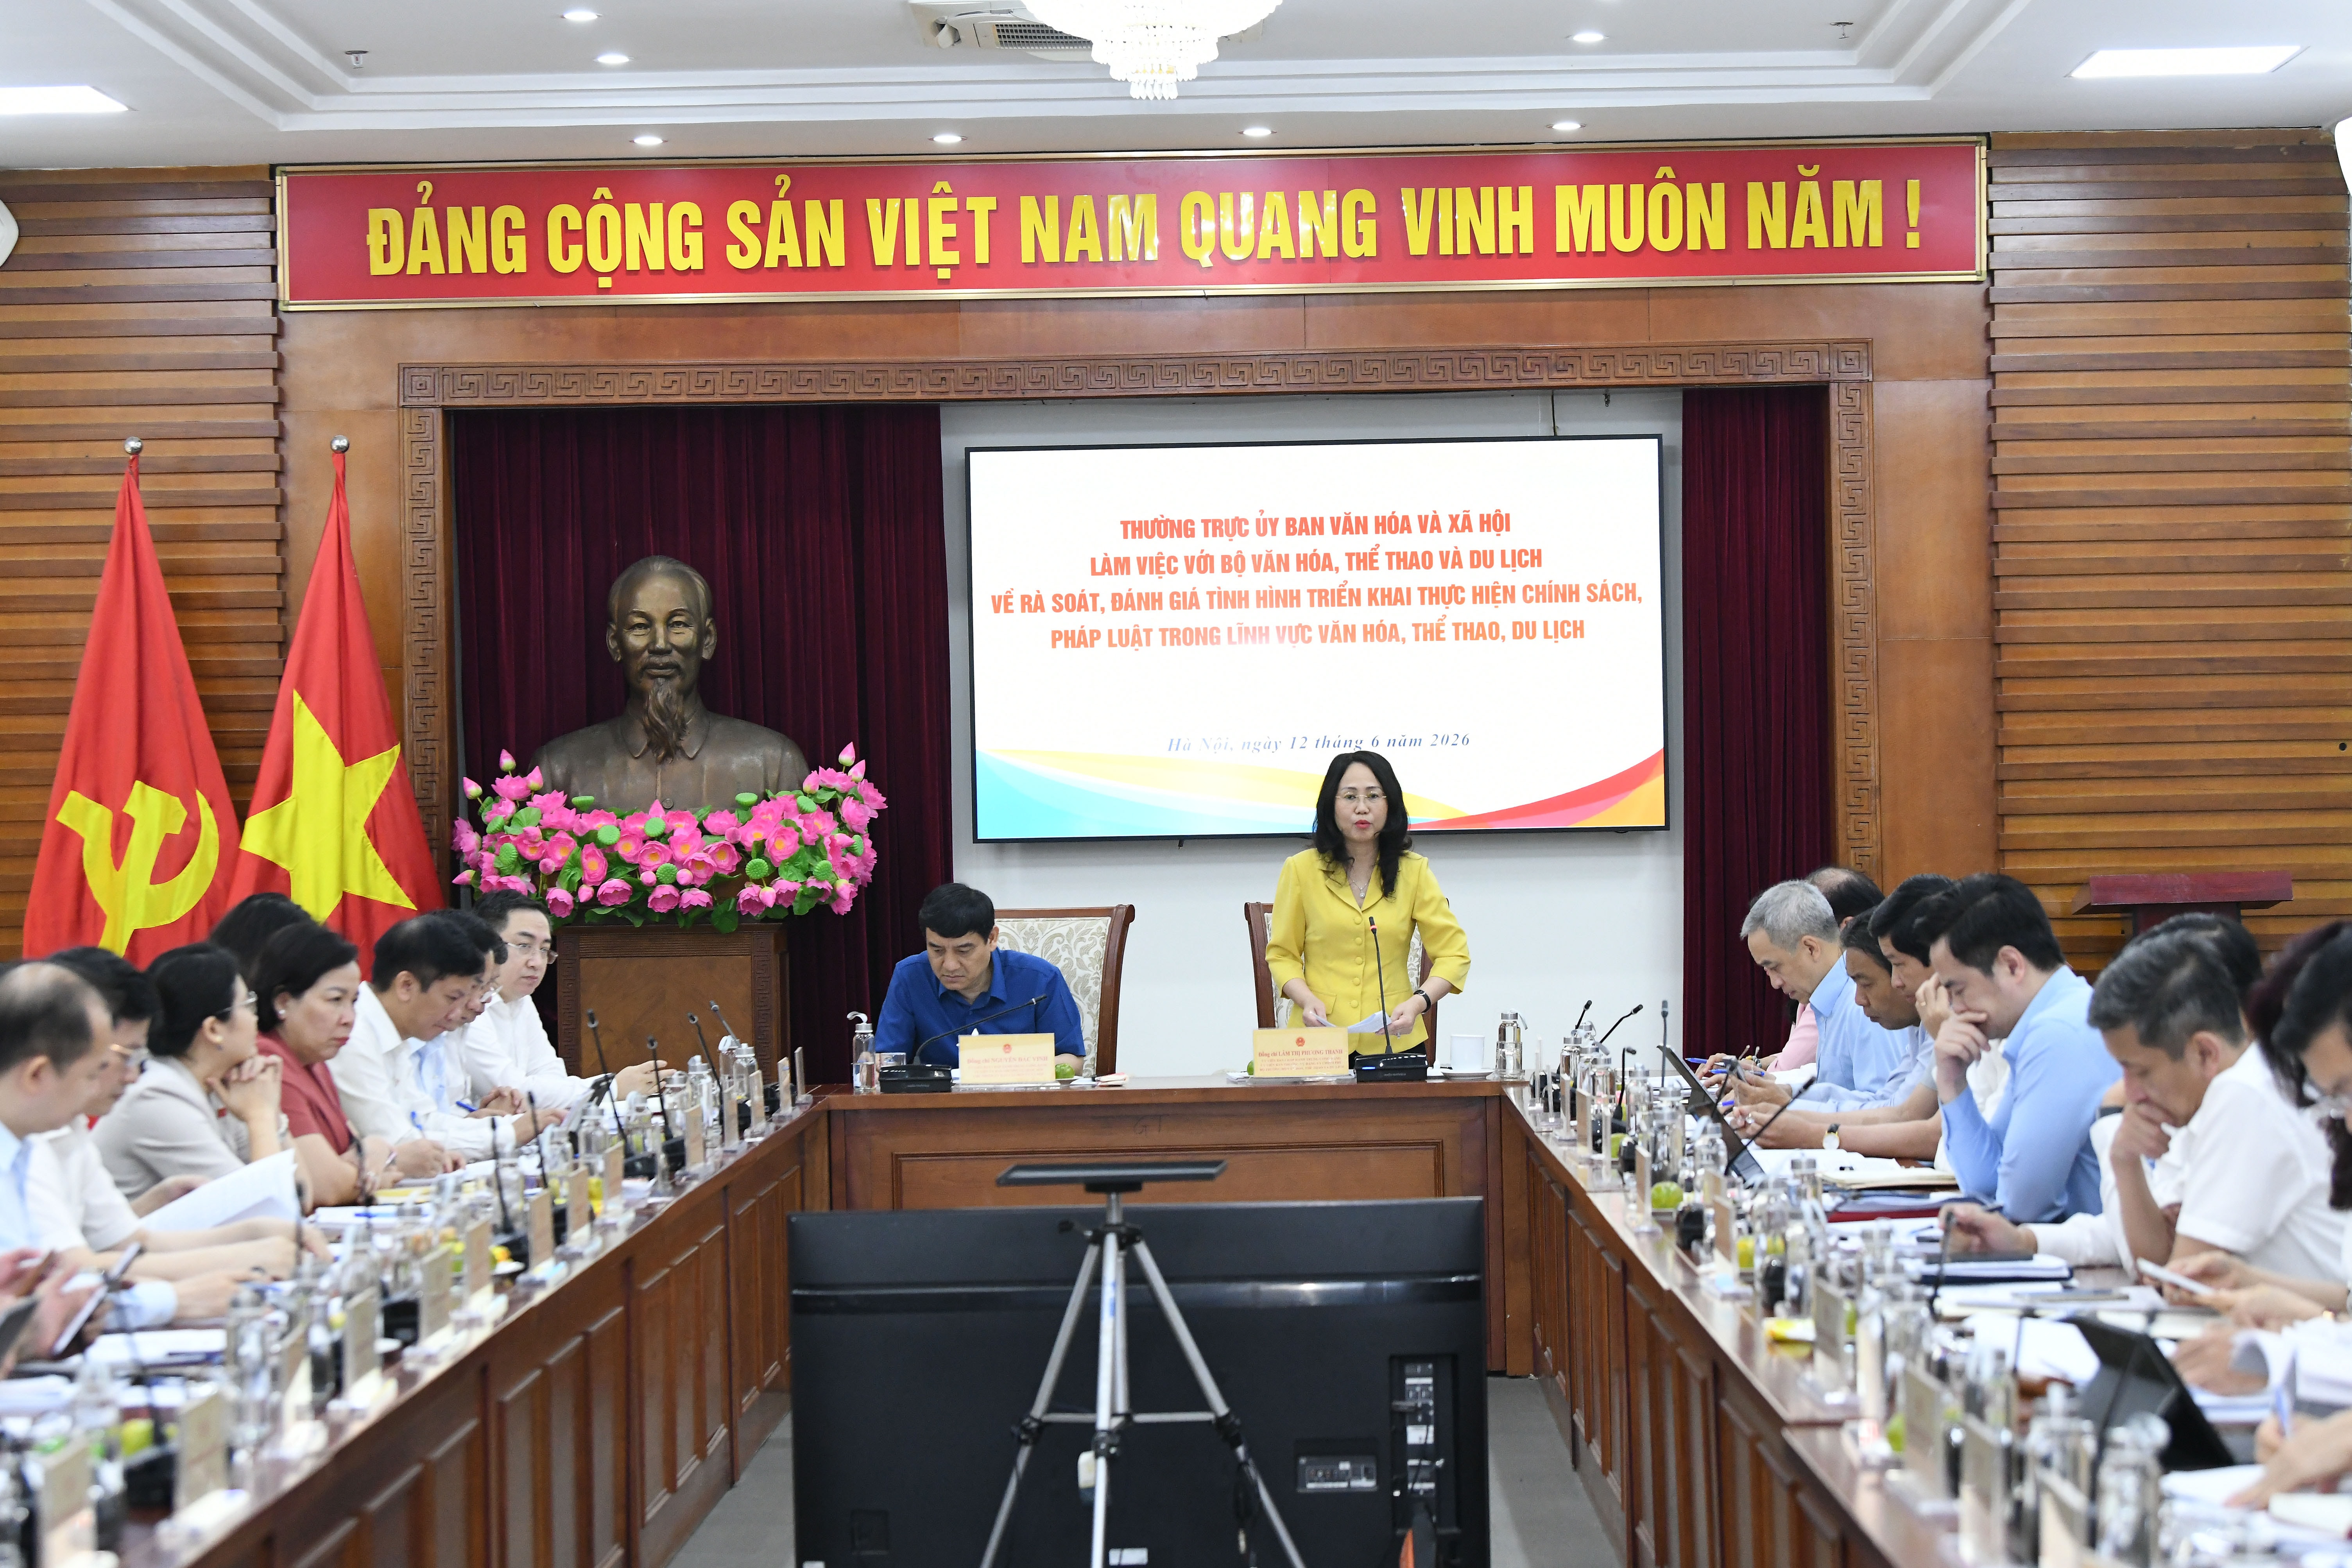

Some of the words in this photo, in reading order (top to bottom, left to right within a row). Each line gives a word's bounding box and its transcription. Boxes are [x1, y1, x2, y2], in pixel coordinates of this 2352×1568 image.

[367, 181, 526, 275] ĐẢNG
[548, 186, 703, 288] CỘNG
[727, 175, 845, 269] SẢN
[867, 182, 996, 279] VIỆT
[1021, 194, 1157, 263] NAM
[1180, 189, 1376, 268] QUANG
[1402, 186, 1533, 255] VINH
[1556, 167, 1725, 252] MUÔN
[1748, 163, 1882, 249] NĂM
[1907, 180, 1919, 247] !
[1120, 514, 1195, 539] THƯỜNG
[1201, 516, 1249, 541] TRỰC
[1256, 509, 1279, 537] ỦY
[1285, 516, 1324, 536] BAN
[1330, 512, 1368, 535] VĂN
[1374, 511, 1412, 534] HÓA
[1417, 510, 1442, 533] VÀ
[1448, 510, 1473, 533] XÃ
[1480, 509, 1510, 536] HỘI
[1091, 553, 1130, 576] LÀM
[1136, 552, 1178, 579] VIỆC
[1184, 549, 1215, 574] VỚI
[1221, 550, 1245, 577] BỘ
[1251, 550, 1290, 573] VĂN
[1296, 548, 1339, 574] HÓA,
[1345, 544, 1380, 572] THỂ
[1385, 551, 1433, 571] THAO
[1439, 546, 1464, 569] VÀ
[1470, 550, 1494, 569] DU
[1501, 548, 1542, 572] LỊCH
[991, 588, 1014, 613] VỀ
[1020, 590, 1045, 613] RÀ
[1052, 589, 1105, 614] SOÁT,
[1111, 588, 1163, 611] ĐÁNH
[1170, 587, 1200, 610] GIÁ
[1206, 586, 1249, 609] TÌNH
[1256, 585, 1300, 608] HÌNH
[1307, 580, 1361, 607] TRIỂN
[1368, 587, 1411, 606] KHAI
[1417, 584, 1465, 609] THỰC
[1472, 581, 1515, 608] HIỆN
[1523, 580, 1580, 604] CHÍNH
[1587, 579, 1642, 604] SÁCH,
[1052, 625, 1101, 649] PHÁP
[1108, 624, 1153, 651] LUẬT
[1159, 627, 1220, 646] TRONG
[1227, 622, 1269, 645] LĨNH
[1276, 623, 1312, 648] VỰC
[1318, 620, 1356, 643] VĂN
[1363, 619, 1406, 644] HÓA,
[1412, 614, 1447, 642] THỂ
[1452, 621, 1505, 642] THAO,
[1512, 621, 1537, 640] DU
[1543, 620, 1584, 643] LỊCH
[1168, 738, 1191, 751] Hà
[1199, 737, 1233, 754] Nội,
[1241, 736, 1281, 753] ngày
[1290, 736, 1308, 749] 12
[1315, 735, 1363, 751] tháng
[1371, 735, 1379, 747] 6
[1387, 734, 1422, 747] năm
[1430, 733, 1470, 746] 2026
